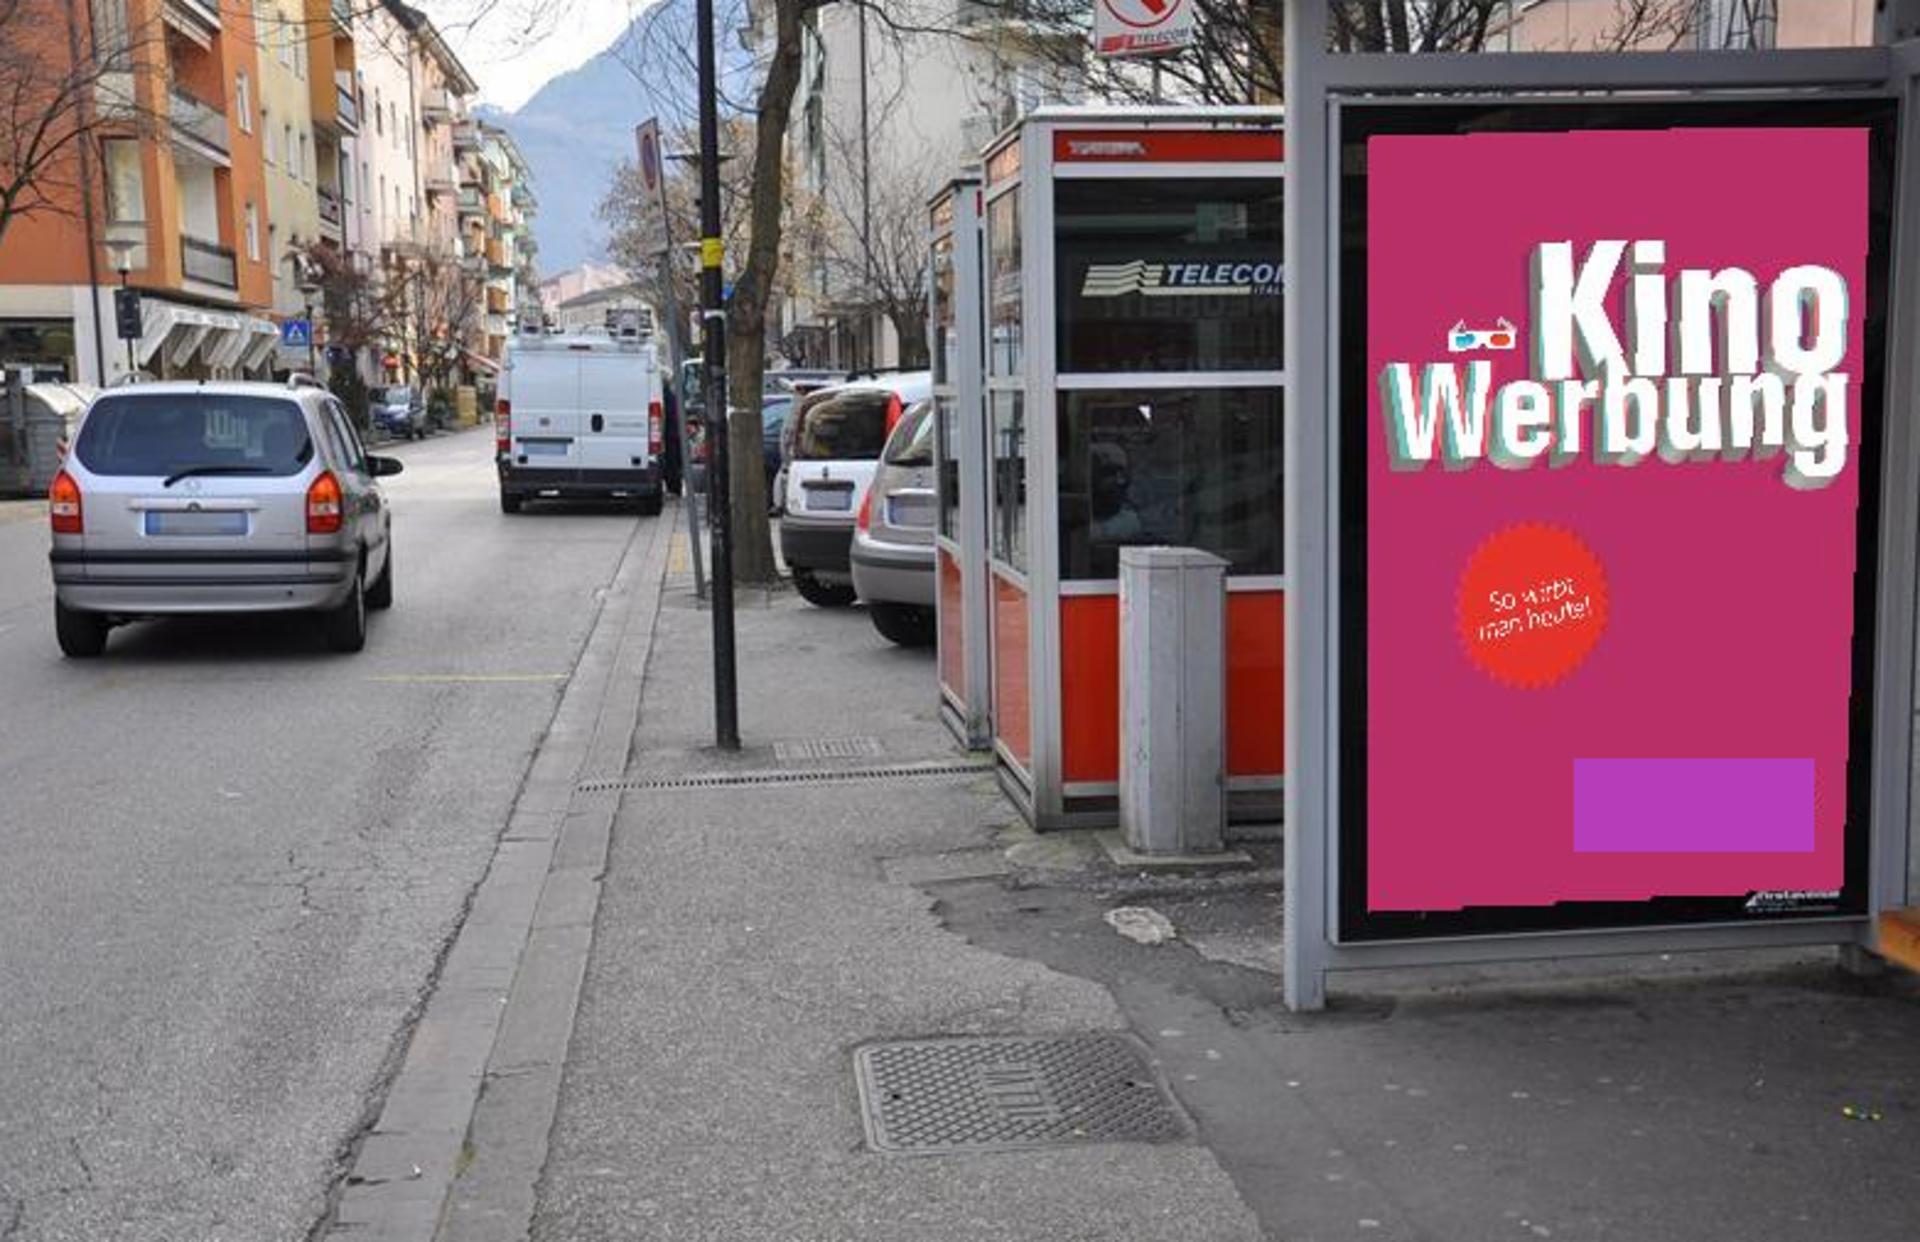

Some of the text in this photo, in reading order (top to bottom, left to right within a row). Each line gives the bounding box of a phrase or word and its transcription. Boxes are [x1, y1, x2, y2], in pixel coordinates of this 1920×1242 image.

[1535, 239, 1848, 380] Kino
[1384, 361, 1850, 486] Werbung
[1489, 590, 1516, 612] So
